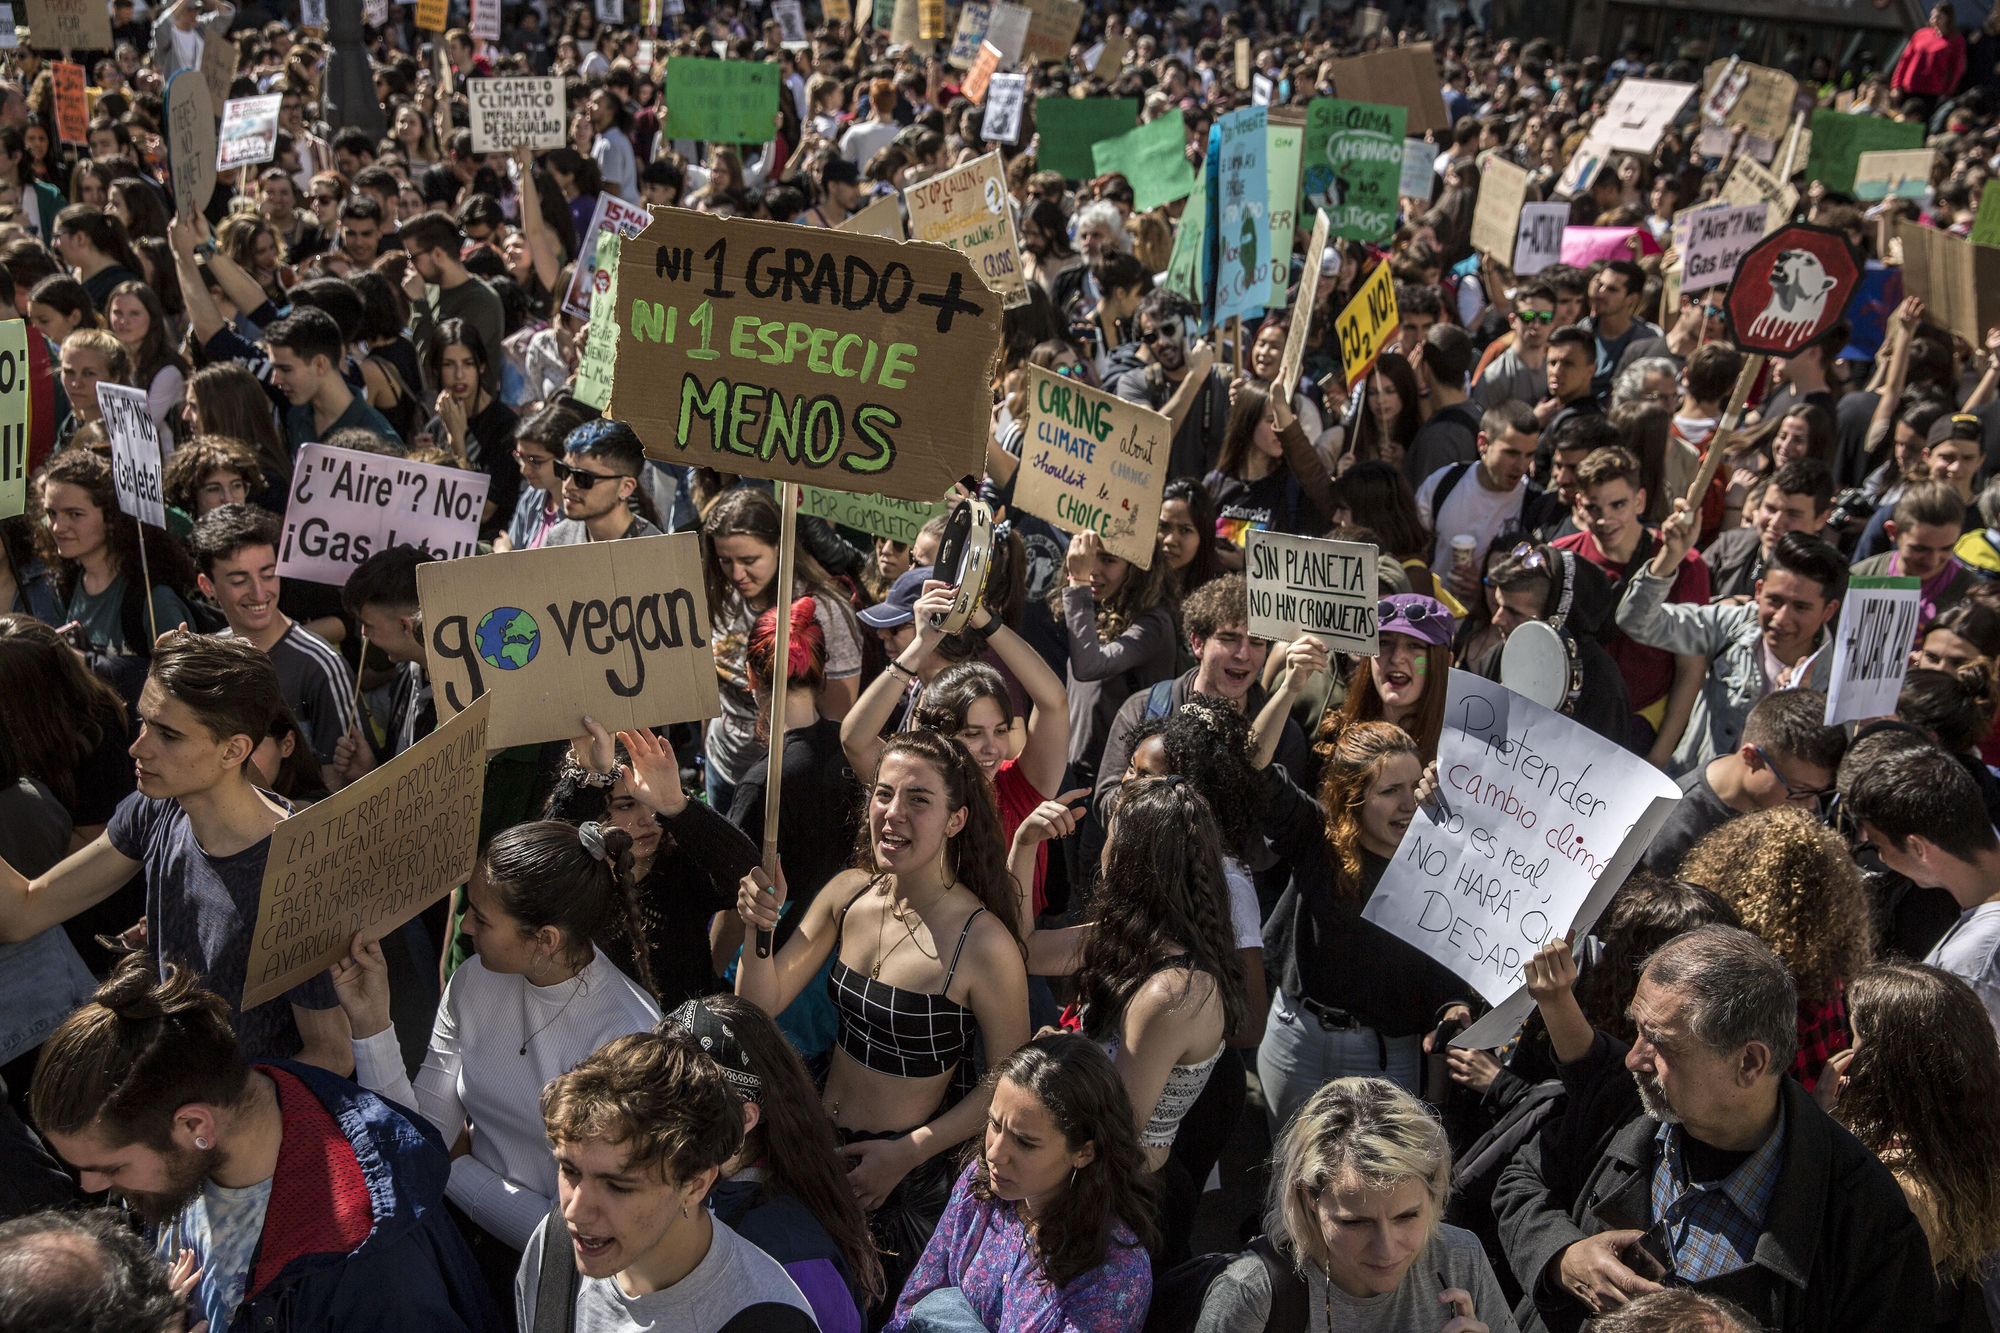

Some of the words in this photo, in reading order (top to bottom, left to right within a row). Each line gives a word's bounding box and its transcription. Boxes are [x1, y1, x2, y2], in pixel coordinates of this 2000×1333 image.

[57, 15, 80, 31] FOR
[473, 81, 490, 93] EL
[493, 80, 552, 93] CAMBIO
[181, 128, 193, 155] NO
[484, 119, 561, 135] DESIGUALDAD
[491, 136, 538, 148] SOCIAL
[533, 110, 547, 120] LA
[1345, 106, 1392, 133] CLIMA
[605, 200, 623, 221] 15
[914, 182, 941, 209] STOP
[943, 165, 984, 198] CALLING
[942, 199, 954, 214] IT
[963, 225, 995, 249] CALLING
[998, 218, 1006, 236] IT
[655, 244, 694, 283] NI
[703, 236, 735, 299] 1
[744, 246, 914, 315] GRADO
[916, 271, 985, 334] +
[983, 248, 1014, 278] CRISIS
[1367, 271, 1394, 336] NO!
[630, 298, 678, 345] NI
[686, 298, 721, 362] 1
[729, 315, 919, 391] ESPECIE
[673, 371, 903, 476] MENOS
[1037, 378, 1114, 443] CARING
[1119, 423, 1158, 466] about
[1037, 421, 1097, 465] CLIMATE
[1110, 459, 1153, 490] CHANGE
[295, 456, 428, 513] ¿"Aire"?
[433, 478, 483, 523] No:
[811, 489, 842, 521] POR
[846, 505, 919, 541] COMPLETO
[1057, 492, 1112, 539] CHOICE
[281, 517, 372, 566] ¡Gas
[1252, 540, 1280, 581] SIN
[1286, 549, 1365, 592] PLANETA
[1250, 588, 1271, 618] NO
[1276, 592, 1297, 623] HAY
[1299, 598, 1375, 638] CROQUETAS
[546, 587, 707, 698] vegan
[1459, 694, 1607, 820] Pretender
[286, 830, 316, 866] LA
[322, 786, 391, 848] TIERRA
[395, 717, 487, 809] PROPORCIONA
[1448, 764, 1538, 830] cambio
[270, 881, 323, 923] FACER
[329, 860, 363, 897] LAS
[367, 806, 460, 874] NECESIDADES
[463, 785, 480, 817] DE
[273, 872, 297, 898] LO
[303, 821, 388, 886] SUFICIENTE
[394, 789, 435, 834] PARA
[1433, 801, 1465, 835] no
[1470, 827, 1499, 860] es
[260, 910, 311, 951] CADA
[386, 852, 427, 894] PERO
[433, 833, 454, 866] NO
[455, 816, 476, 853] LA
[1407, 836, 1448, 877] NO
[1453, 862, 1522, 923] HARÁ
[262, 919, 343, 983] AVARICIA
[348, 913, 366, 938] DE
[368, 882, 415, 927] CADA
[418, 843, 473, 902] HOMBRE
